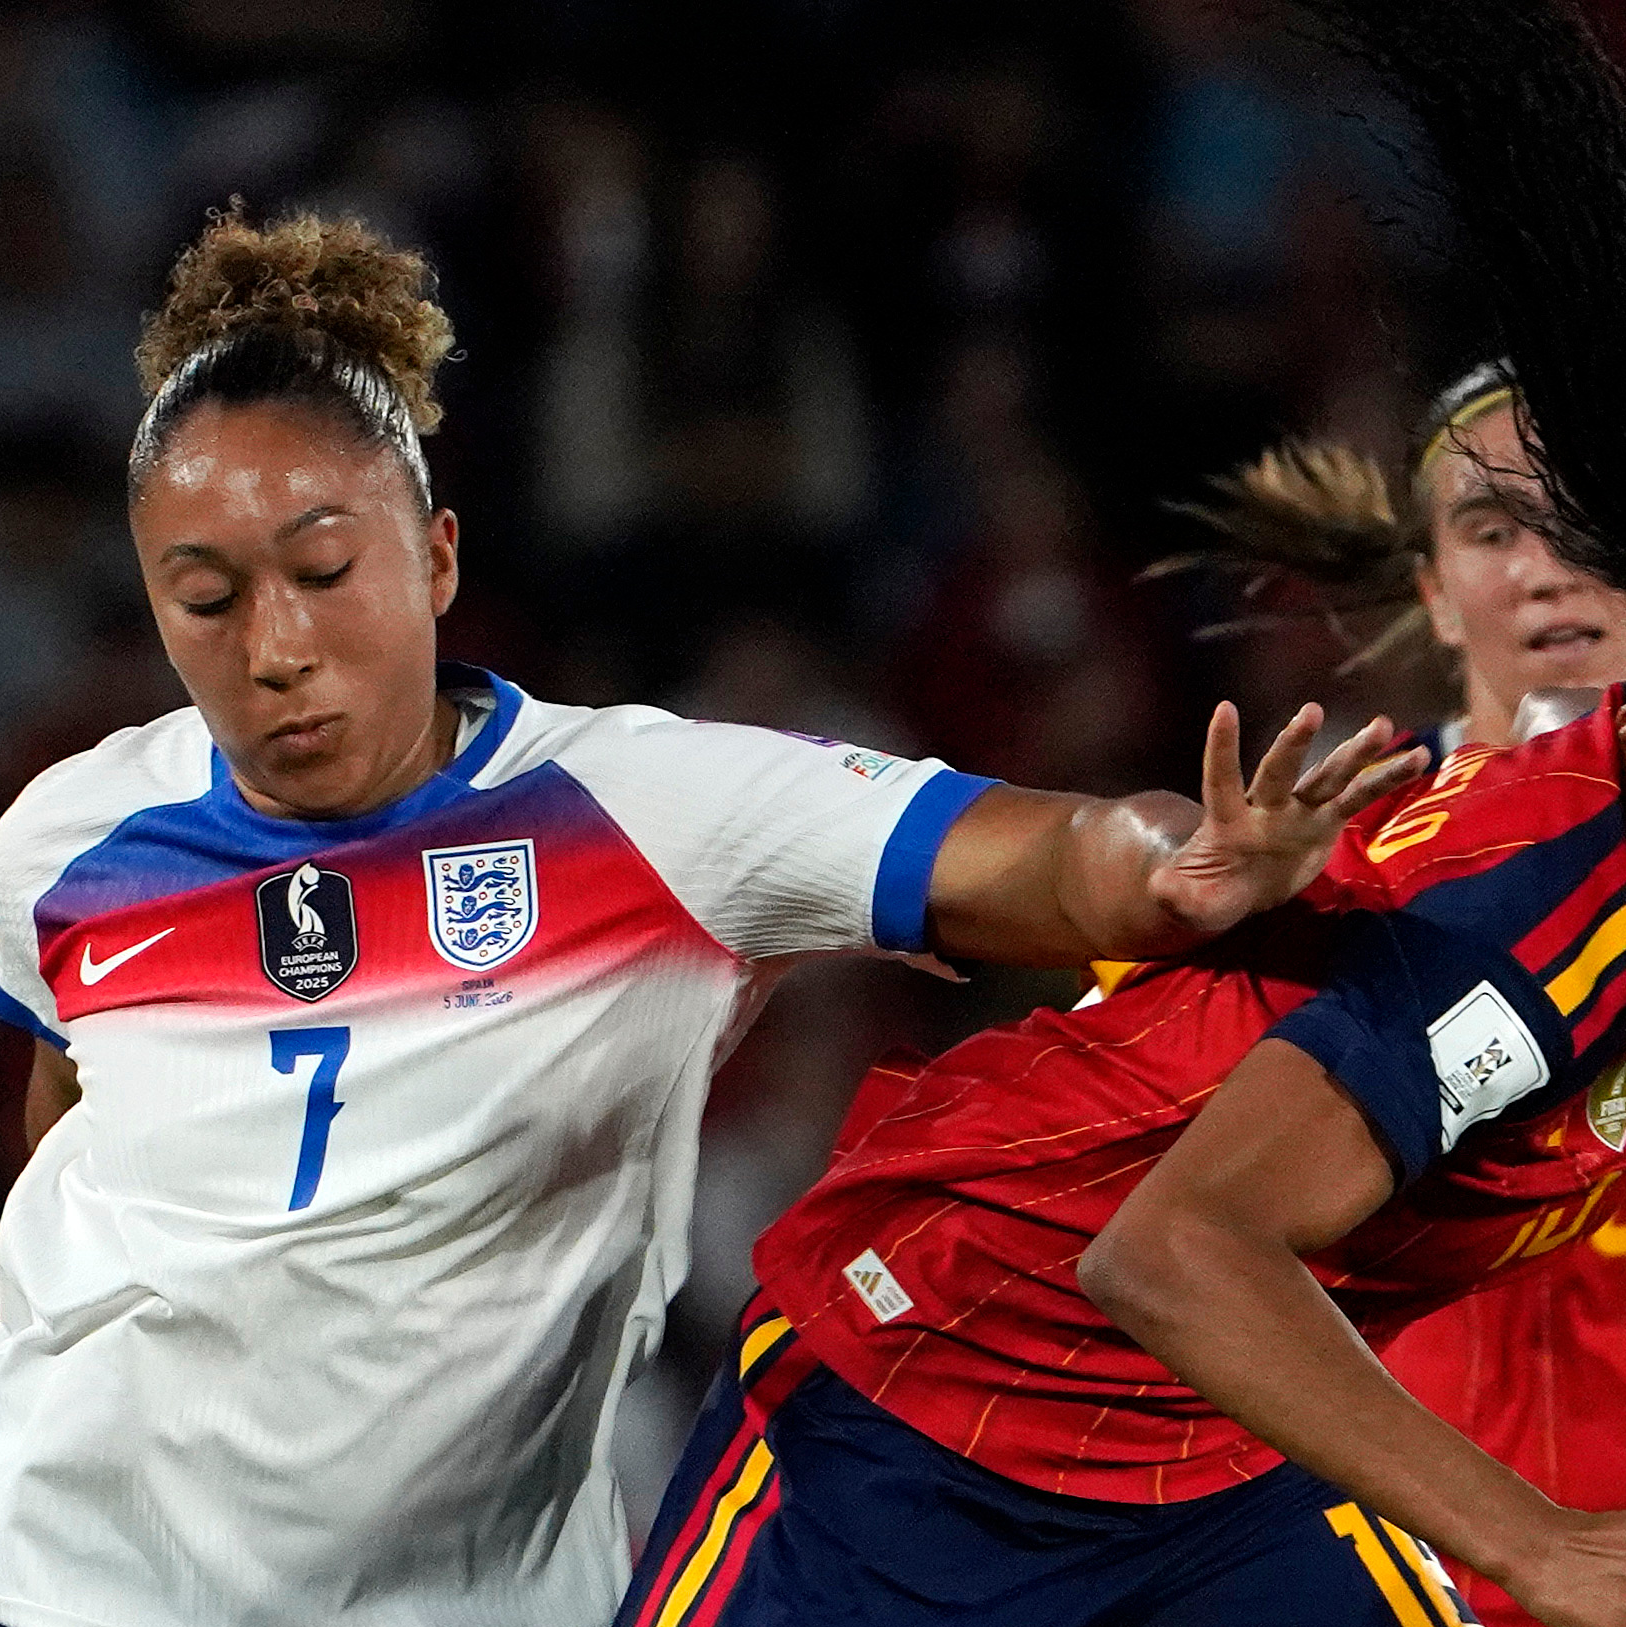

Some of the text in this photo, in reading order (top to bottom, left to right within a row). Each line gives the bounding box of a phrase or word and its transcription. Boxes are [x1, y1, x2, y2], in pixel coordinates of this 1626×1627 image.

[280, 951, 339, 966] EUROPEAN
[278, 961, 343, 977] CHAMPIONS
[295, 976, 329, 990] 2025
[271, 1027, 351, 1211] 7
